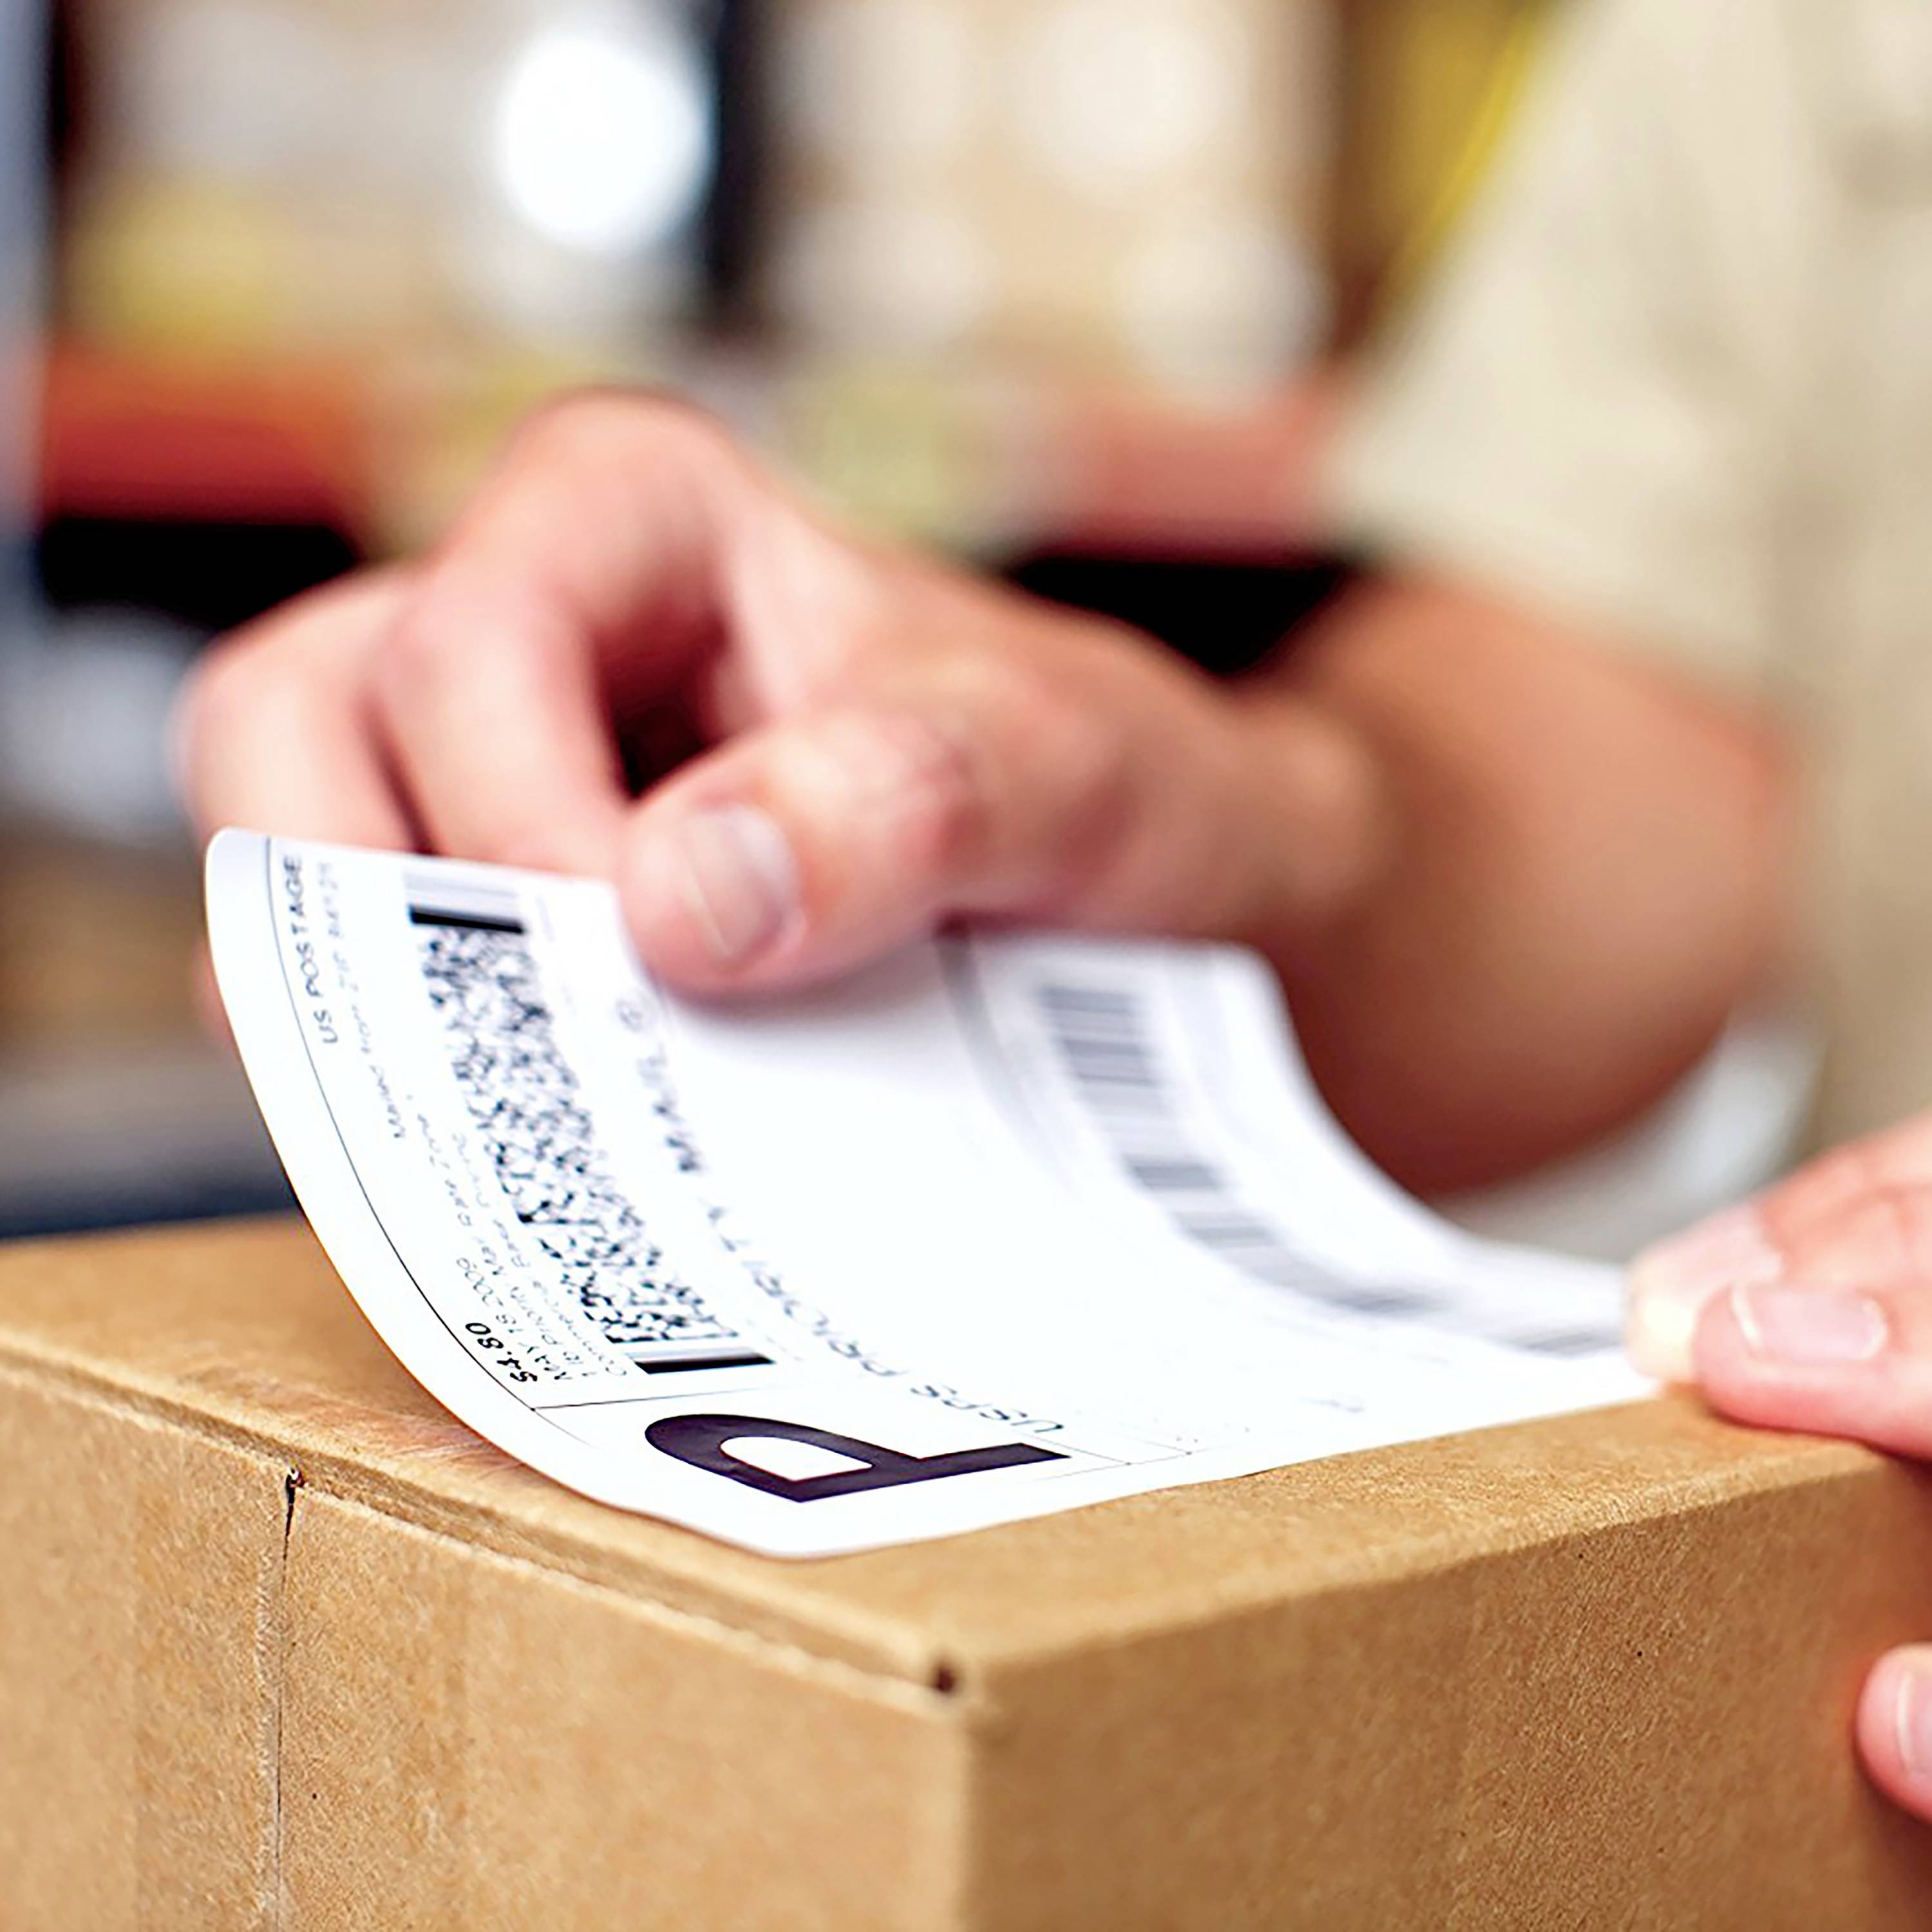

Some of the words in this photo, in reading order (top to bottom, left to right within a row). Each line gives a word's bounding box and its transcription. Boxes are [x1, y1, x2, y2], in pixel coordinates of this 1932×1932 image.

[283, 854, 323, 998] POSTAGE
[314, 1007, 337, 1044] US
[645, 1414, 1072, 1502] P
